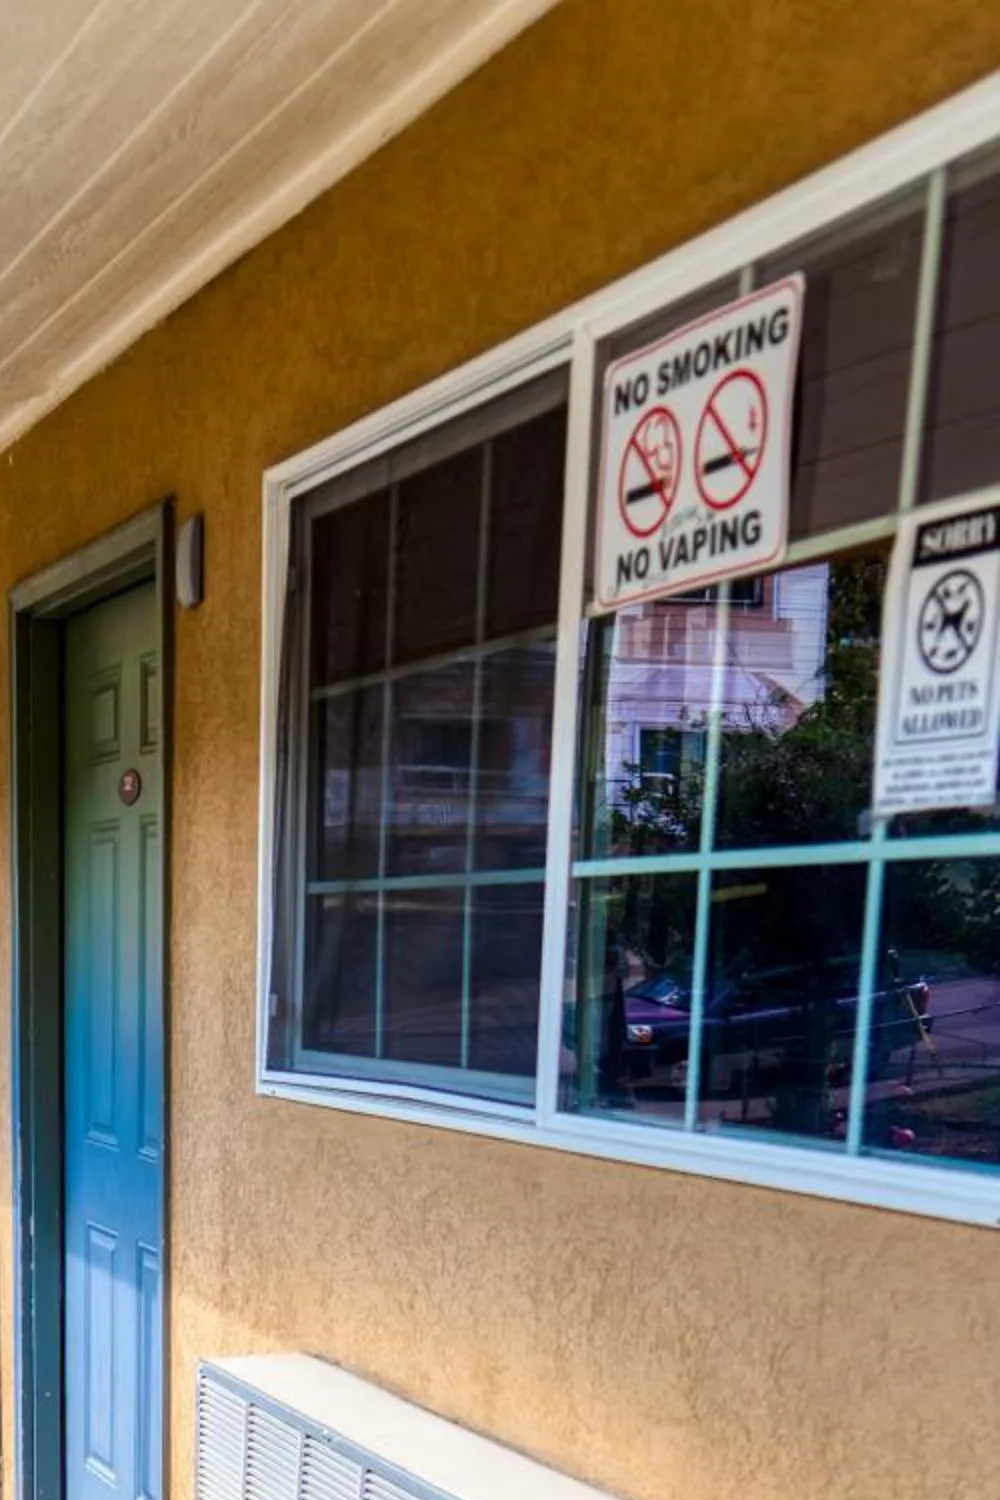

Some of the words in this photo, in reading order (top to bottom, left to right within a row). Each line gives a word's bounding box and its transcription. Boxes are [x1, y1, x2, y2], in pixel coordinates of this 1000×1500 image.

[614, 374, 649, 416] NO
[656, 307, 790, 396] SMOKING
[616, 547, 649, 586] NO
[658, 509, 761, 572] VAPING
[921, 512, 996, 557] SORRY
[910, 684, 935, 706] NO
[937, 680, 978, 703] PETS
[902, 708, 982, 736] ALLOWED
